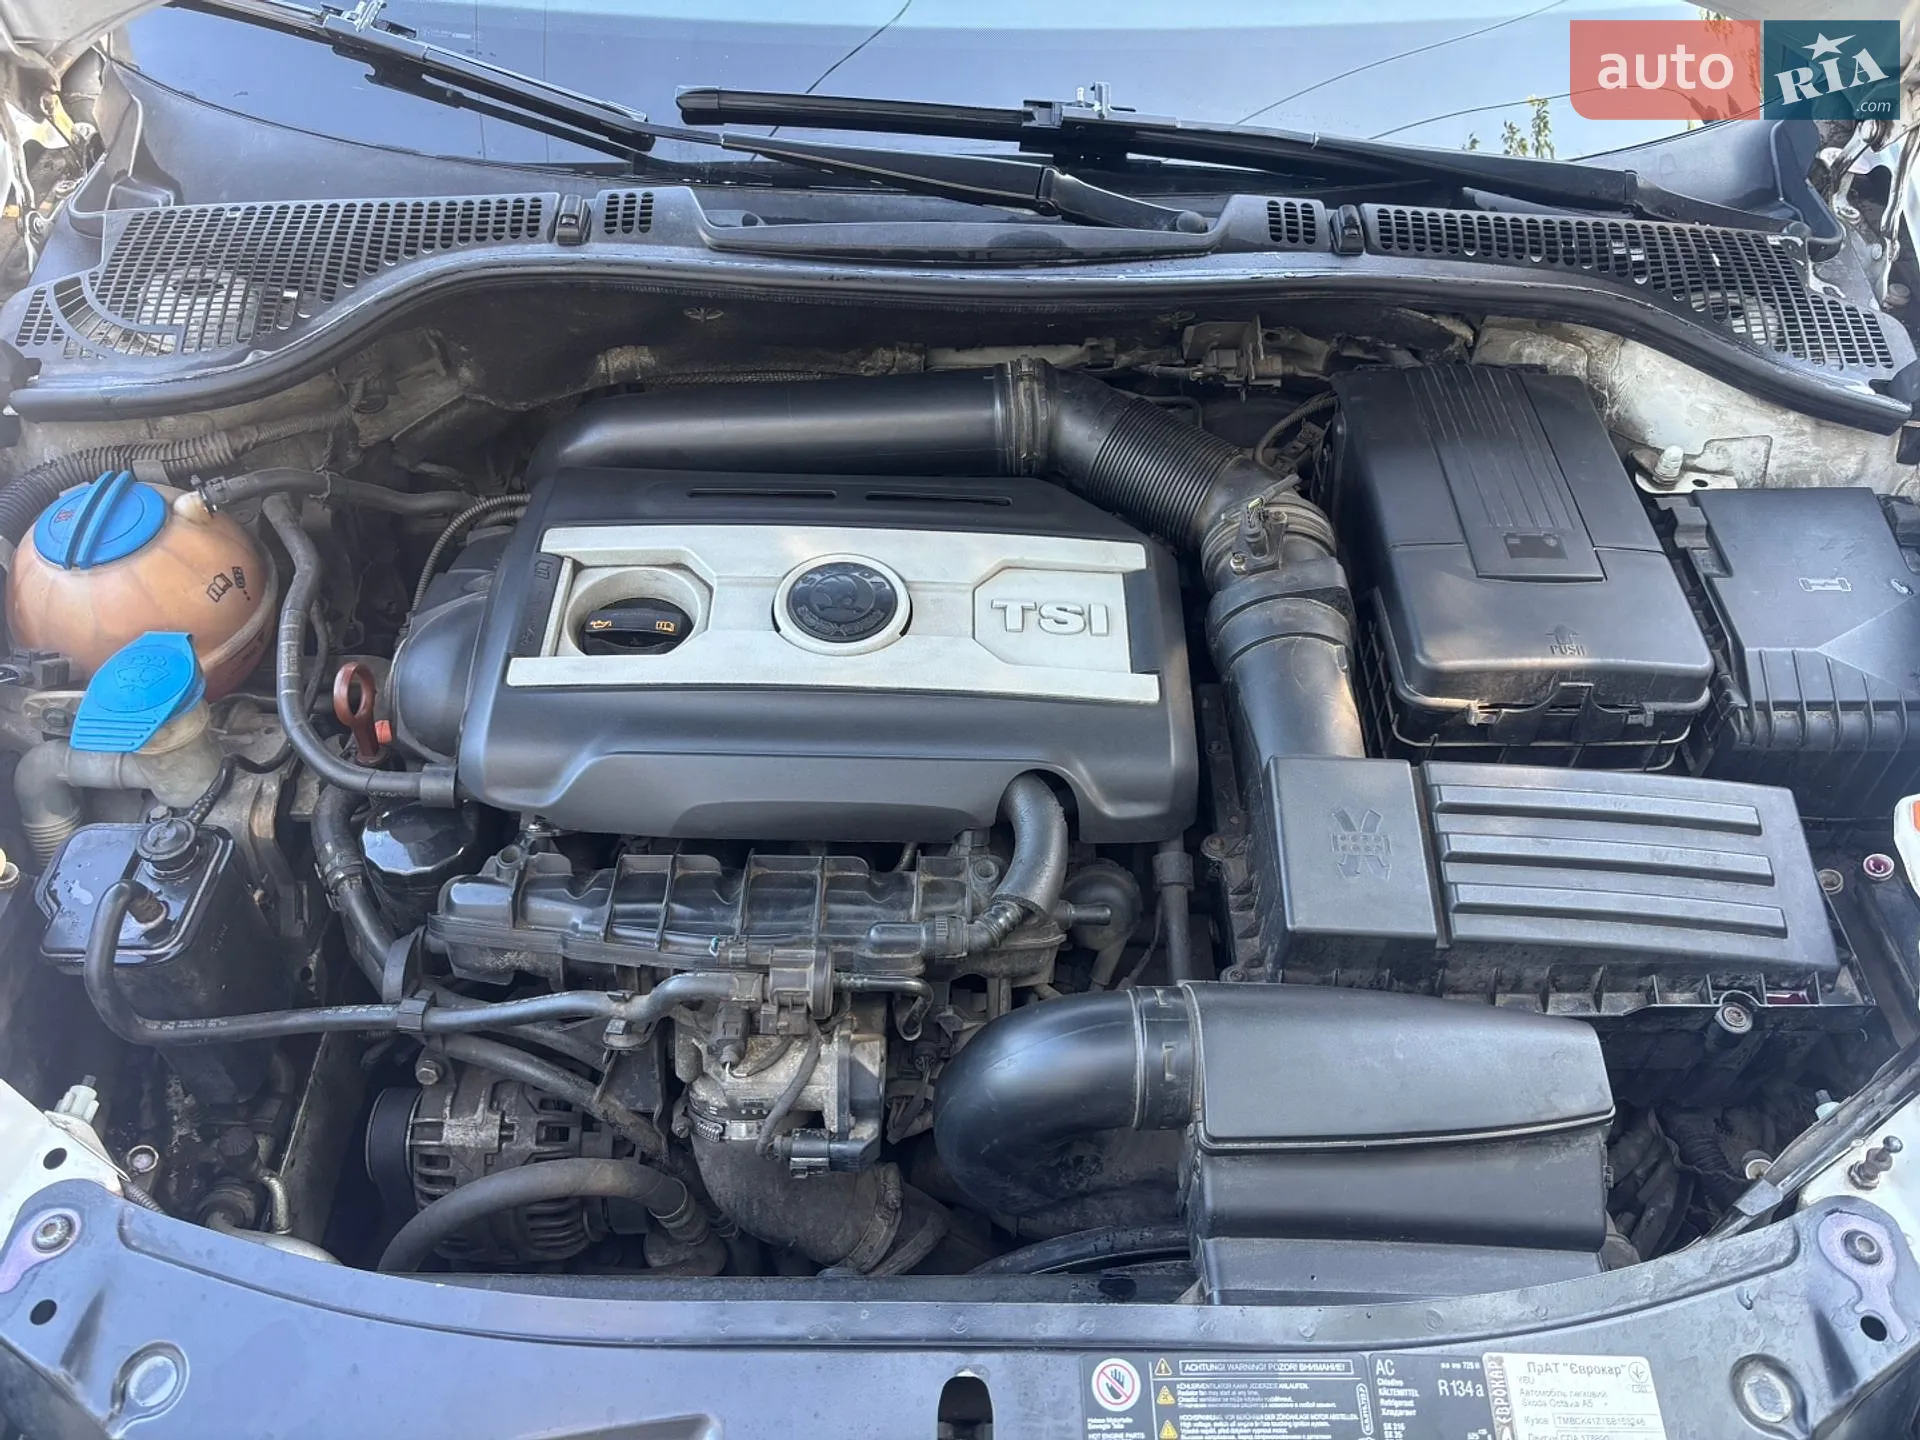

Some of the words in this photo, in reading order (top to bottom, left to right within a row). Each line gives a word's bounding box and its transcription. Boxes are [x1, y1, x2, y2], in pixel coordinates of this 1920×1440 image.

[990, 599, 1110, 637] TSI
[1550, 644, 1586, 656] PUSH
[1376, 1359, 1395, 1376] AC
[1527, 1361, 1561, 1376] ПрАТ
